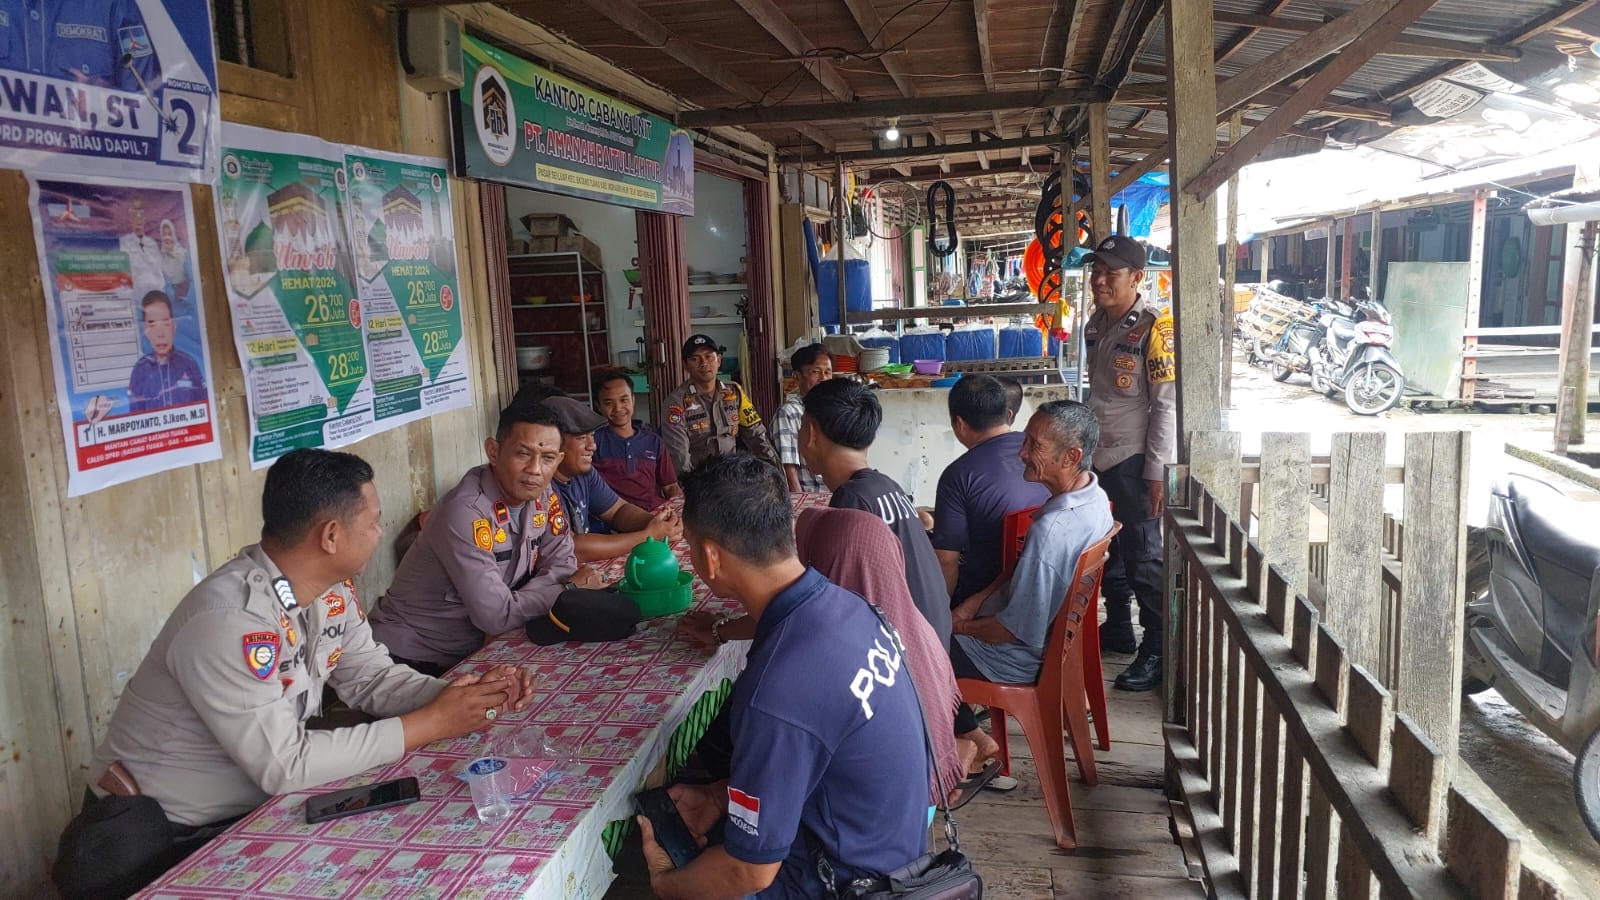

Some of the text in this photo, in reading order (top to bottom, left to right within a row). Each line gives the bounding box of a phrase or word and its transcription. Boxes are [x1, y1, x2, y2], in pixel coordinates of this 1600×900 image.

[0, 75, 141, 130] WAN, ST
[534, 73, 587, 118] KANTOR
[588, 98, 631, 133] CABANG
[630, 115, 652, 141] UNIT
[168, 98, 200, 156] 2
[26, 127, 67, 147] PROV.
[69, 133, 102, 151] RIAU
[104, 138, 140, 156] DAPIL
[142, 142, 149, 156] 7
[523, 120, 545, 154] PT.
[546, 128, 597, 166] AMANAH
[274, 243, 336, 270] Umroh
[386, 236, 430, 260] Umroh
[391, 264, 430, 277] HEMAT 2024
[281, 276, 337, 290] HEMAT 2024
[407, 280, 425, 305] 26
[424, 280, 436, 292] 700
[304, 294, 330, 323] 26
[329, 294, 343, 306] 700
[426, 293, 437, 303] Juta
[330, 308, 345, 320] Juta
[368, 319, 375, 329] 12
[375, 317, 388, 328] Hari
[258, 340, 276, 353] Hari
[423, 331, 440, 355] 28
[328, 353, 349, 381] 28
[348, 365, 364, 377] Juta
[97, 425, 107, 438] H.
[108, 415, 161, 435] MARPOYANTO,
